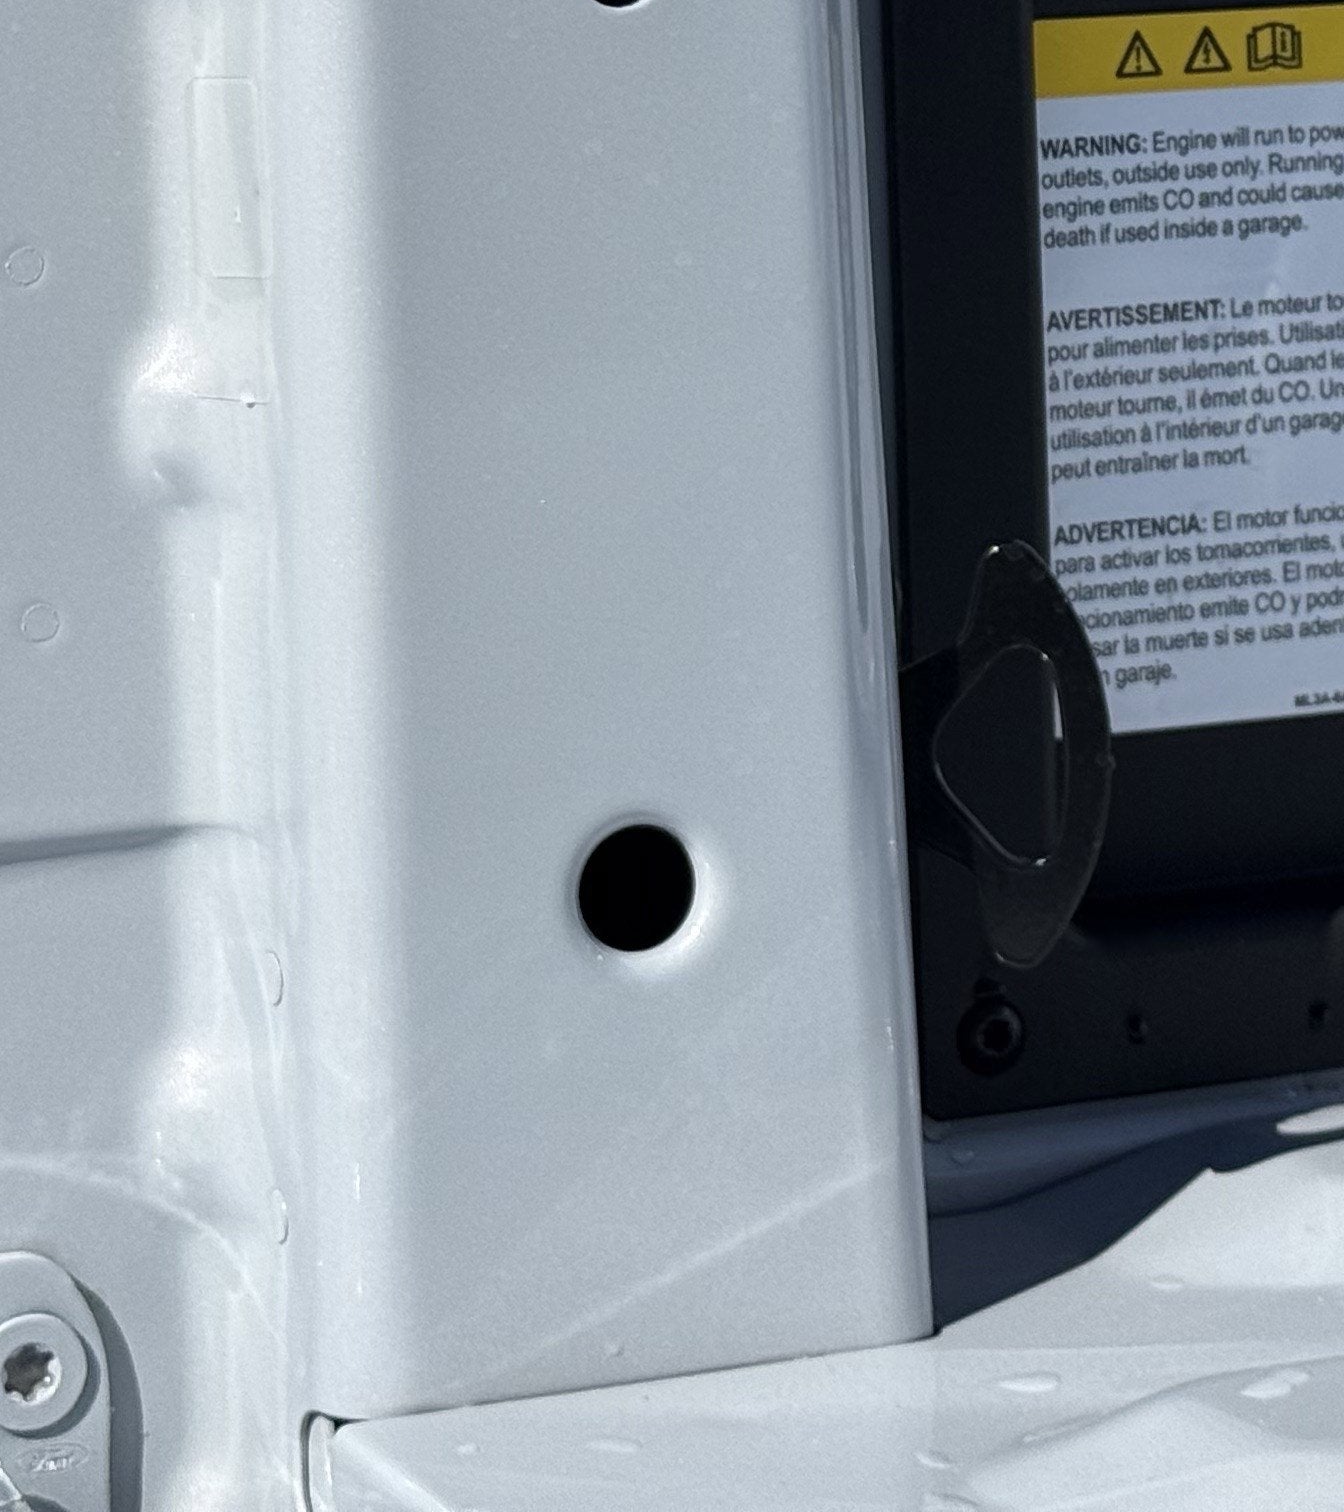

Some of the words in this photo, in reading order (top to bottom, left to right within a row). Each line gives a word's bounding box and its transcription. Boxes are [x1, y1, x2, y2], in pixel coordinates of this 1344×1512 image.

[1039, 133, 1148, 160] WARNING:
[1152, 130, 1217, 157] Engine
[1220, 127, 1250, 148] will
[1253, 128, 1284, 146] run
[1287, 125, 1306, 144] to
[1112, 161, 1180, 186] outside
[1184, 162, 1218, 180] use
[1268, 151, 1344, 176] Running
[1042, 196, 1105, 223] engine
[1109, 192, 1159, 214] emits
[1163, 188, 1194, 211] CO
[1198, 186, 1233, 209] and
[1237, 182, 1286, 206] could
[1291, 182, 1344, 202] cause
[1044, 226, 1096, 249] death
[1100, 222, 1110, 244] if
[1115, 221, 1159, 244] used
[1164, 217, 1218, 240] inside
[1222, 219, 1233, 237] a
[1238, 214, 1308, 240] garage.
[1046, 298, 1225, 333] AVERTISSEMENT:
[1230, 298, 1253, 318] Le
[1258, 295, 1322, 316] moteur
[1048, 343, 1088, 366] pour
[1093, 334, 1178, 359] alimenter
[1182, 330, 1209, 352] les
[1214, 327, 1273, 354] prises.
[1048, 370, 1060, 393] à
[1264, 350, 1326, 375] Quand
[1049, 399, 1114, 422] moteur
[1199, 387, 1248, 409] émet
[1250, 384, 1274, 405] du
[1050, 426, 1136, 452] utilisation
[1140, 422, 1152, 444] à
[1245, 413, 1285, 435] d'un
[1052, 458, 1091, 484] peut
[1183, 449, 1199, 469] la
[1054, 513, 1206, 546] ADVERTENCIA:
[1213, 511, 1231, 532] El
[1236, 509, 1288, 530] motor
[1056, 556, 1095, 576] para
[1100, 550, 1160, 571] activar
[1165, 544, 1192, 565] los
[1196, 534, 1335, 562] tomacorrientes,
[1067, 577, 1148, 602] olamente
[1154, 576, 1178, 595] en
[1283, 561, 1300, 583] El
[1080, 602, 1195, 630] cionamiento
[1200, 596, 1249, 619] emite
[1254, 590, 1286, 615] CO
[1291, 595, 1301, 618] y
[1093, 640, 1118, 657] sar
[1124, 634, 1140, 655] la
[1146, 630, 1208, 652] muerte
[1214, 625, 1228, 646] si
[1234, 628, 1255, 644] se
[1262, 623, 1293, 642] usa
[1116, 664, 1176, 689] garaje.
